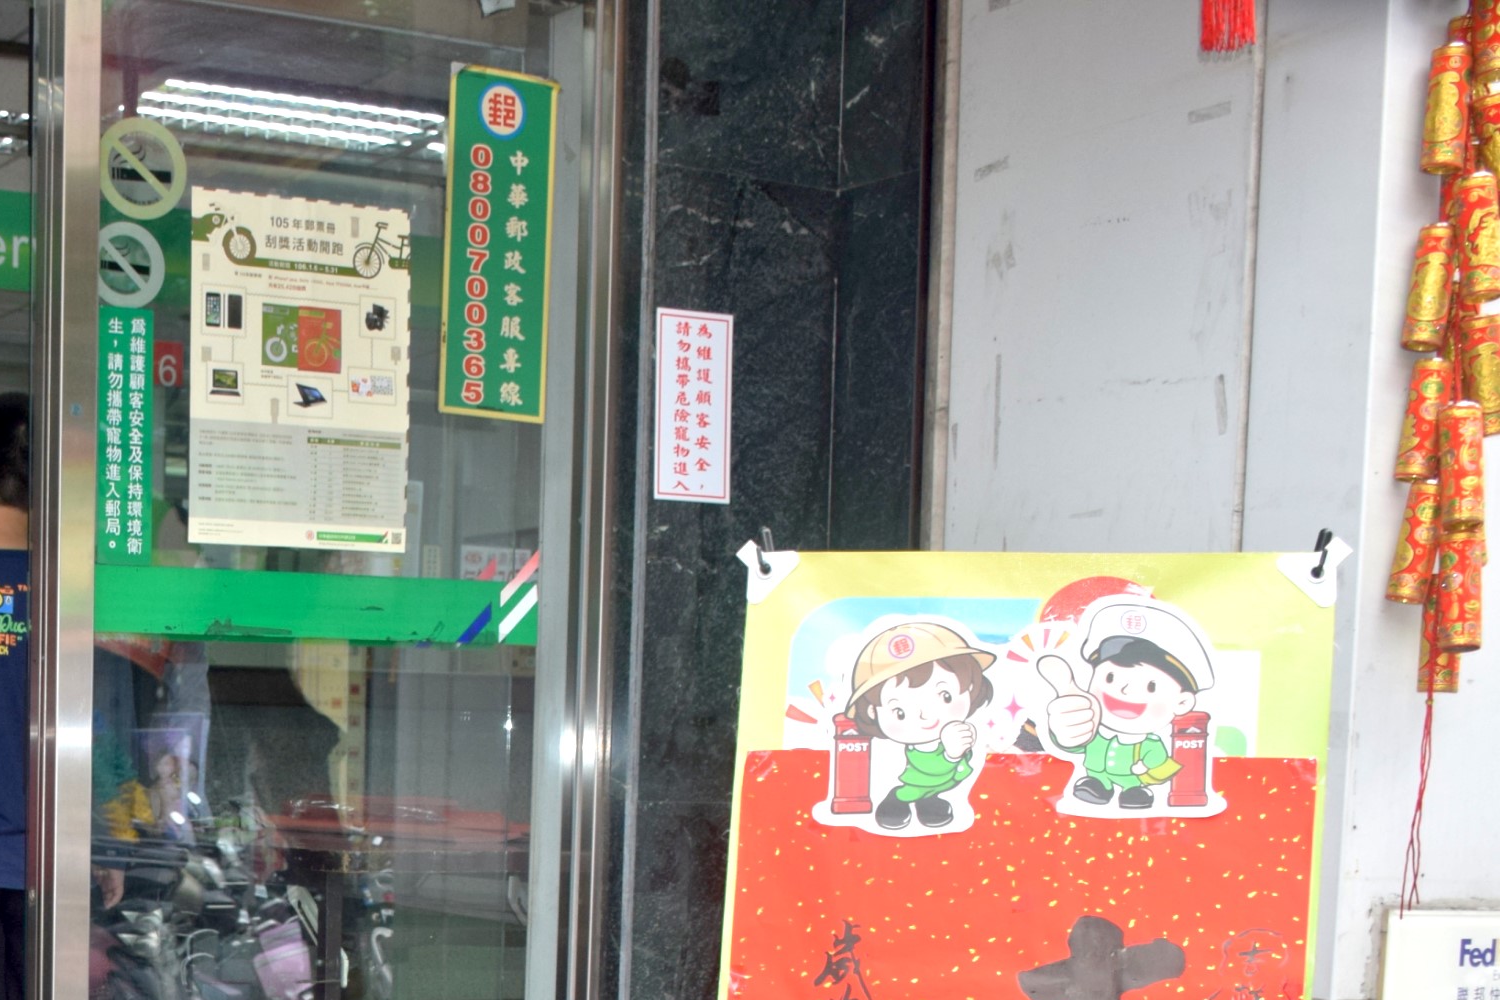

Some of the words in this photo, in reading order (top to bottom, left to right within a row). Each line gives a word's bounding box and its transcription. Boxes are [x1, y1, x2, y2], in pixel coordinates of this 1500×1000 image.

[488, 92, 516, 129] 郵
[270, 216, 289, 229] 105
[461, 143, 493, 405] 0800700365
[499, 150, 530, 407] 中華郵政客服專線
[157, 354, 177, 387] 6
[672, 321, 692, 491] 請勿攜帶危險寵物進入
[838, 742, 869, 753] POST
[1175, 739, 1205, 750] POST
[1459, 939, 1500, 968] Fed
